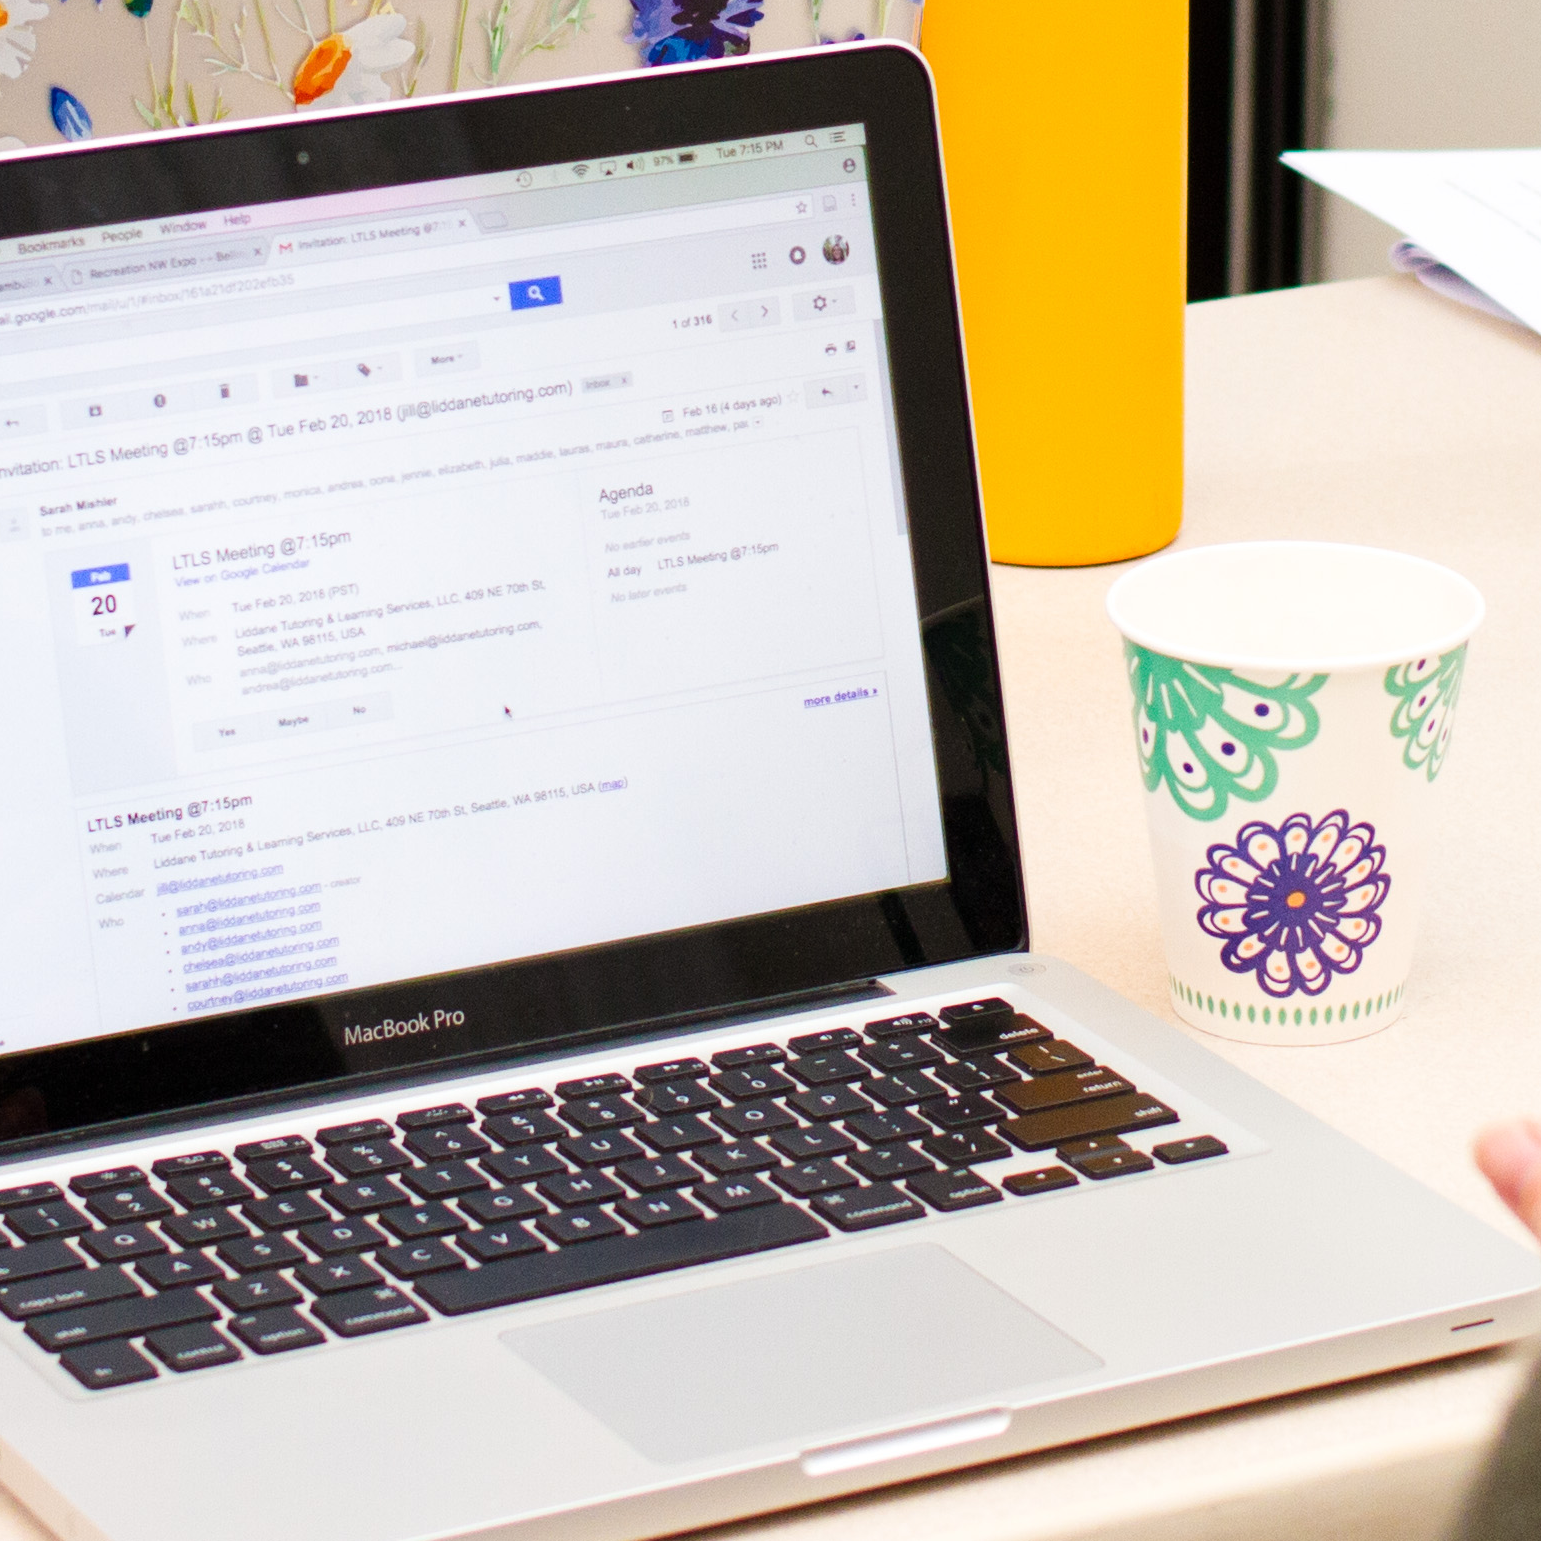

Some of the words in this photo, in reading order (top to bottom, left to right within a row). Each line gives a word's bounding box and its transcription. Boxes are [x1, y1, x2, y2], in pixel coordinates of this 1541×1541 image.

[715, 147, 737, 158] Tue
[739, 142, 761, 156] 7:15
[760, 139, 784, 153] PM
[17, 236, 85, 256] Bookmarks
[101, 228, 143, 242] People
[159, 221, 207, 235] Window
[223, 213, 252, 226] Help
[89, 264, 146, 279] Recreation
[148, 260, 167, 270] NW
[169, 257, 197, 269] Expo
[672, 319, 678, 329] 1
[681, 317, 691, 329] of
[693, 314, 713, 327] 316
[682, 406, 703, 418] Feb
[720, 402, 731, 413] (4
[732, 399, 757, 411] days
[759, 394, 782, 408] ago)
[67, 449, 106, 469] LTLS
[109, 443, 169, 462] Meeting
[172, 432, 243, 456] @7:15pm
[247, 426, 263, 445] @
[267, 423, 295, 438] Tue
[298, 418, 327, 433] Feb
[330, 413, 353, 430] 20,
[356, 406, 393, 426] 2018
[599, 483, 654, 505] Agenda
[39, 503, 73, 517] Sarah
[172, 550, 212, 571] LTLS
[215, 543, 276, 563] Meeting
[280, 531, 352, 557] @7:15pm
[625, 566, 642, 576] day
[657, 555, 685, 571] LTLS
[686, 551, 728, 565] Meeting
[91, 593, 117, 616] 20
[231, 601, 253, 613] Tue
[254, 597, 277, 609] Feb
[327, 582, 359, 600] (PST)
[235, 624, 278, 639] Liddane
[280, 617, 324, 631] Tutoring
[326, 613, 335, 624] &
[337, 607, 384, 623] Learning
[464, 588, 485, 601] 409
[486, 585, 503, 598] NE
[99, 628, 117, 637] Tue
[280, 637, 300, 649] WA
[340, 626, 366, 640] USA
[804, 693, 831, 709] more
[834, 687, 869, 705] details
[218, 728, 236, 737] Yes
[278, 716, 309, 728] Maybe
[352, 706, 367, 715] No
[87, 814, 124, 833] LTLS
[127, 807, 183, 825] Meeting
[186, 795, 253, 819] @7:15pm
[153, 854, 197, 870] Liddane
[199, 846, 244, 861] Tutoring
[246, 842, 254, 853] &
[257, 835, 304, 852] Learning
[385, 815, 406, 828] 409
[408, 811, 424, 824] NE
[427, 808, 451, 821] 70th
[512, 793, 532, 806] WA
[571, 782, 596, 796] USA
[598, 779, 628, 793] (map)
[150, 832, 172, 844] Tue
[174, 828, 196, 840] Feb
[217, 818, 245, 834] 2018
[344, 1012, 431, 1046] MacBook
[433, 1009, 466, 1030] Pro
[999, 1026, 1040, 1041] delete
[1076, 1068, 1105, 1080] enter
[1082, 1079, 1123, 1094] return
[1135, 1105, 1163, 1119] shift
